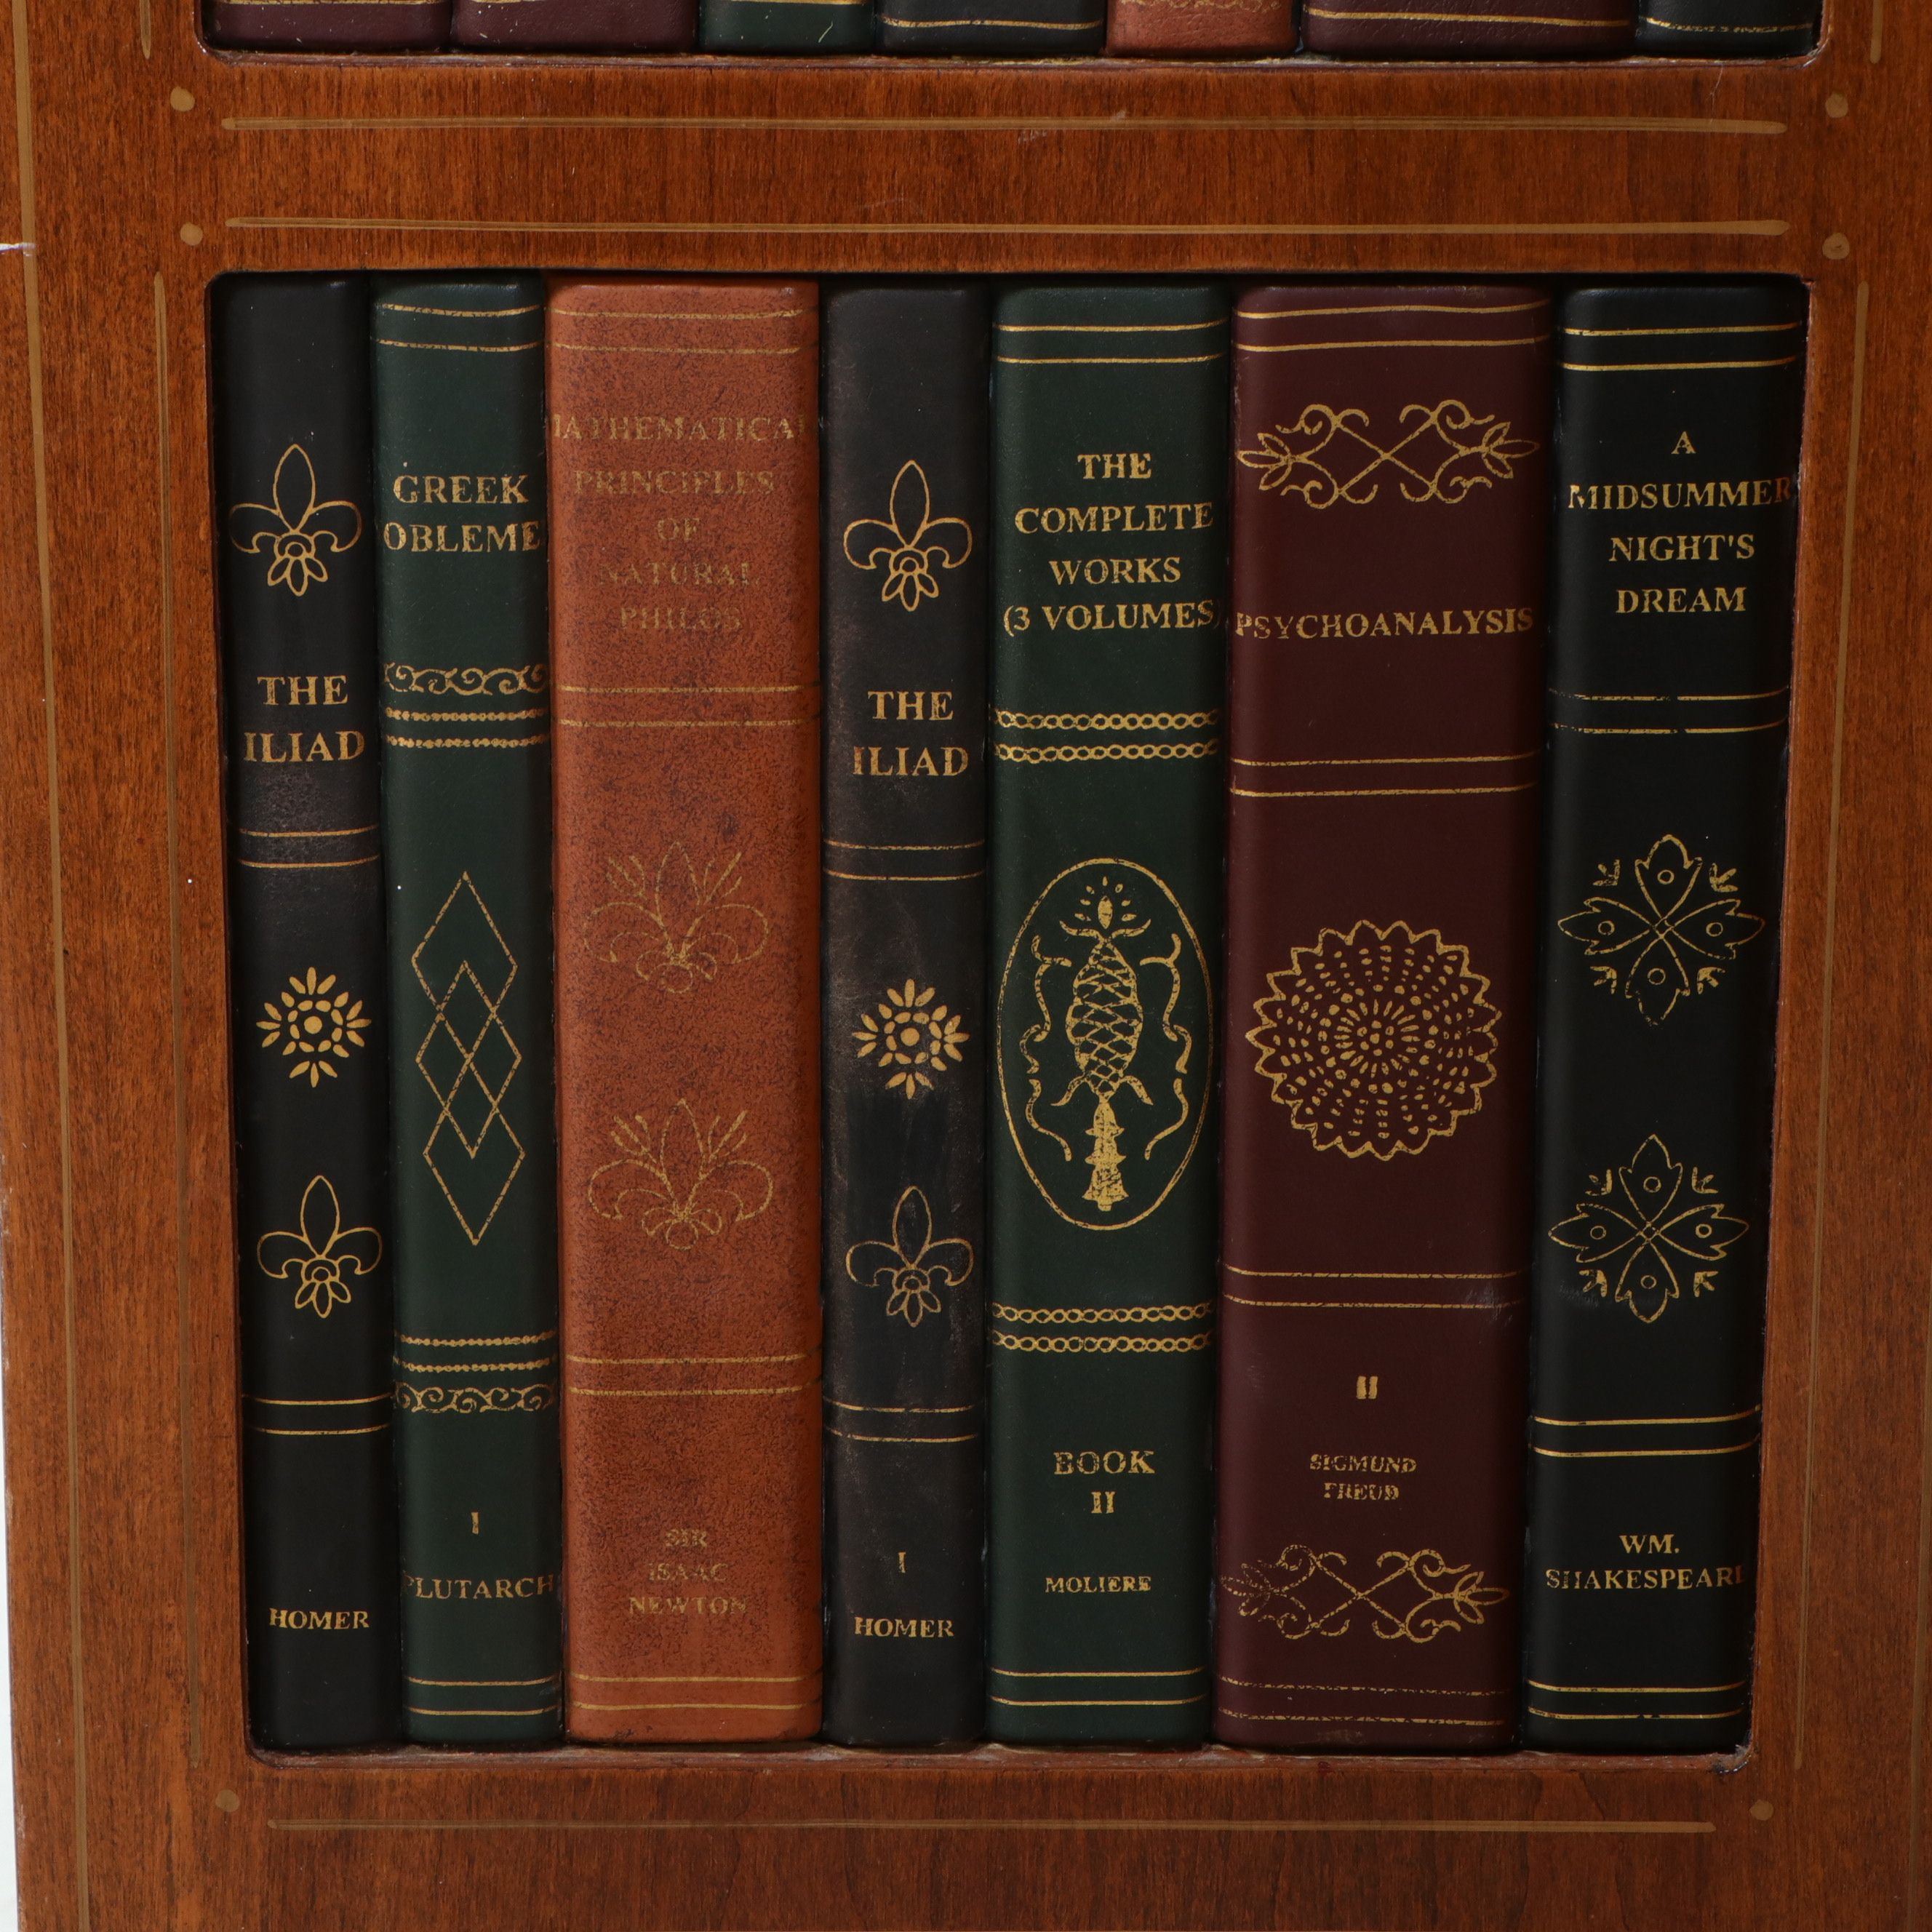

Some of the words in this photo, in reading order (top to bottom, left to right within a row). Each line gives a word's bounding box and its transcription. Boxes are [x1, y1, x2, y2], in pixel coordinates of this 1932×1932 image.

[1671, 431, 1696, 455] A
[1077, 452, 1151, 479] THE
[394, 474, 529, 504] GREEK
[575, 470, 775, 495] PRINCIPLES
[1568, 476, 1793, 509] MIDSUMMER
[657, 516, 700, 541] OF
[1014, 502, 1214, 534] COMPLETE
[383, 520, 540, 554] OBLEME
[1608, 533, 1756, 562] NIGHT'S
[1048, 556, 1182, 586] WORKS
[1616, 586, 1747, 614] DREAM
[1003, 604, 1031, 637] (3
[1235, 607, 1533, 640] PSYCHOANALYSIS
[257, 674, 348, 706] THE
[867, 690, 954, 721] THE
[243, 730, 365, 764] ILIAD
[853, 746, 969, 777] ILIAD
[1053, 1450, 1155, 1476] BOOK
[1309, 1453, 1418, 1473] SIGMUND
[1091, 1490, 1115, 1514] II
[1323, 1482, 1400, 1501] FREUD
[1618, 1533, 1680, 1554] WM.
[898, 1551, 907, 1574] I
[1045, 1576, 1151, 1594] MOLIERE
[269, 1607, 370, 1630] HOMER
[628, 1596, 749, 1615] NEWTON
[854, 1616, 955, 1639] HOMER
